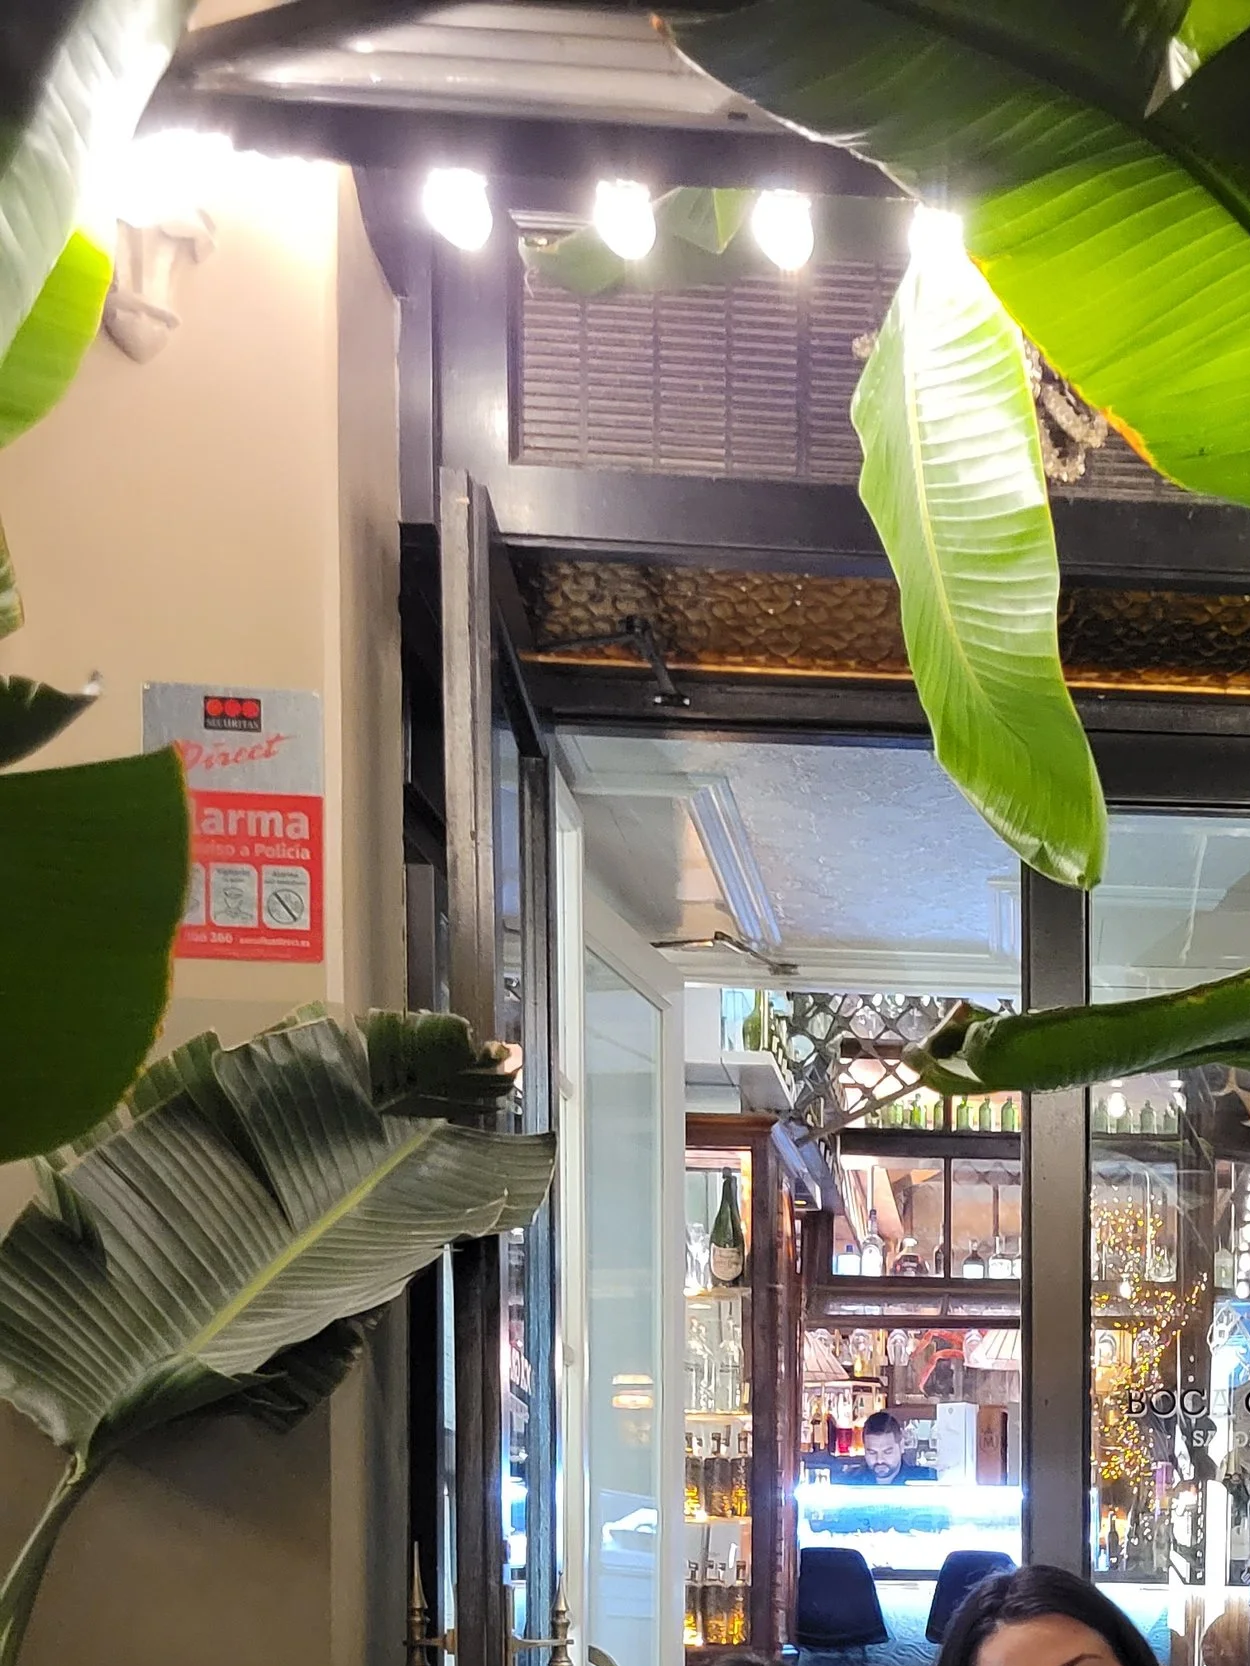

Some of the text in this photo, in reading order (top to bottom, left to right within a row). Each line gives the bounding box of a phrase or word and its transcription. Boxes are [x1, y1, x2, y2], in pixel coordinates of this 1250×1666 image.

[181, 733, 290, 771] Direct
[187, 797, 310, 839] larma
[240, 845, 251, 857] a
[254, 842, 311, 860] Policía
[1126, 1388, 1234, 1419] BOCA
